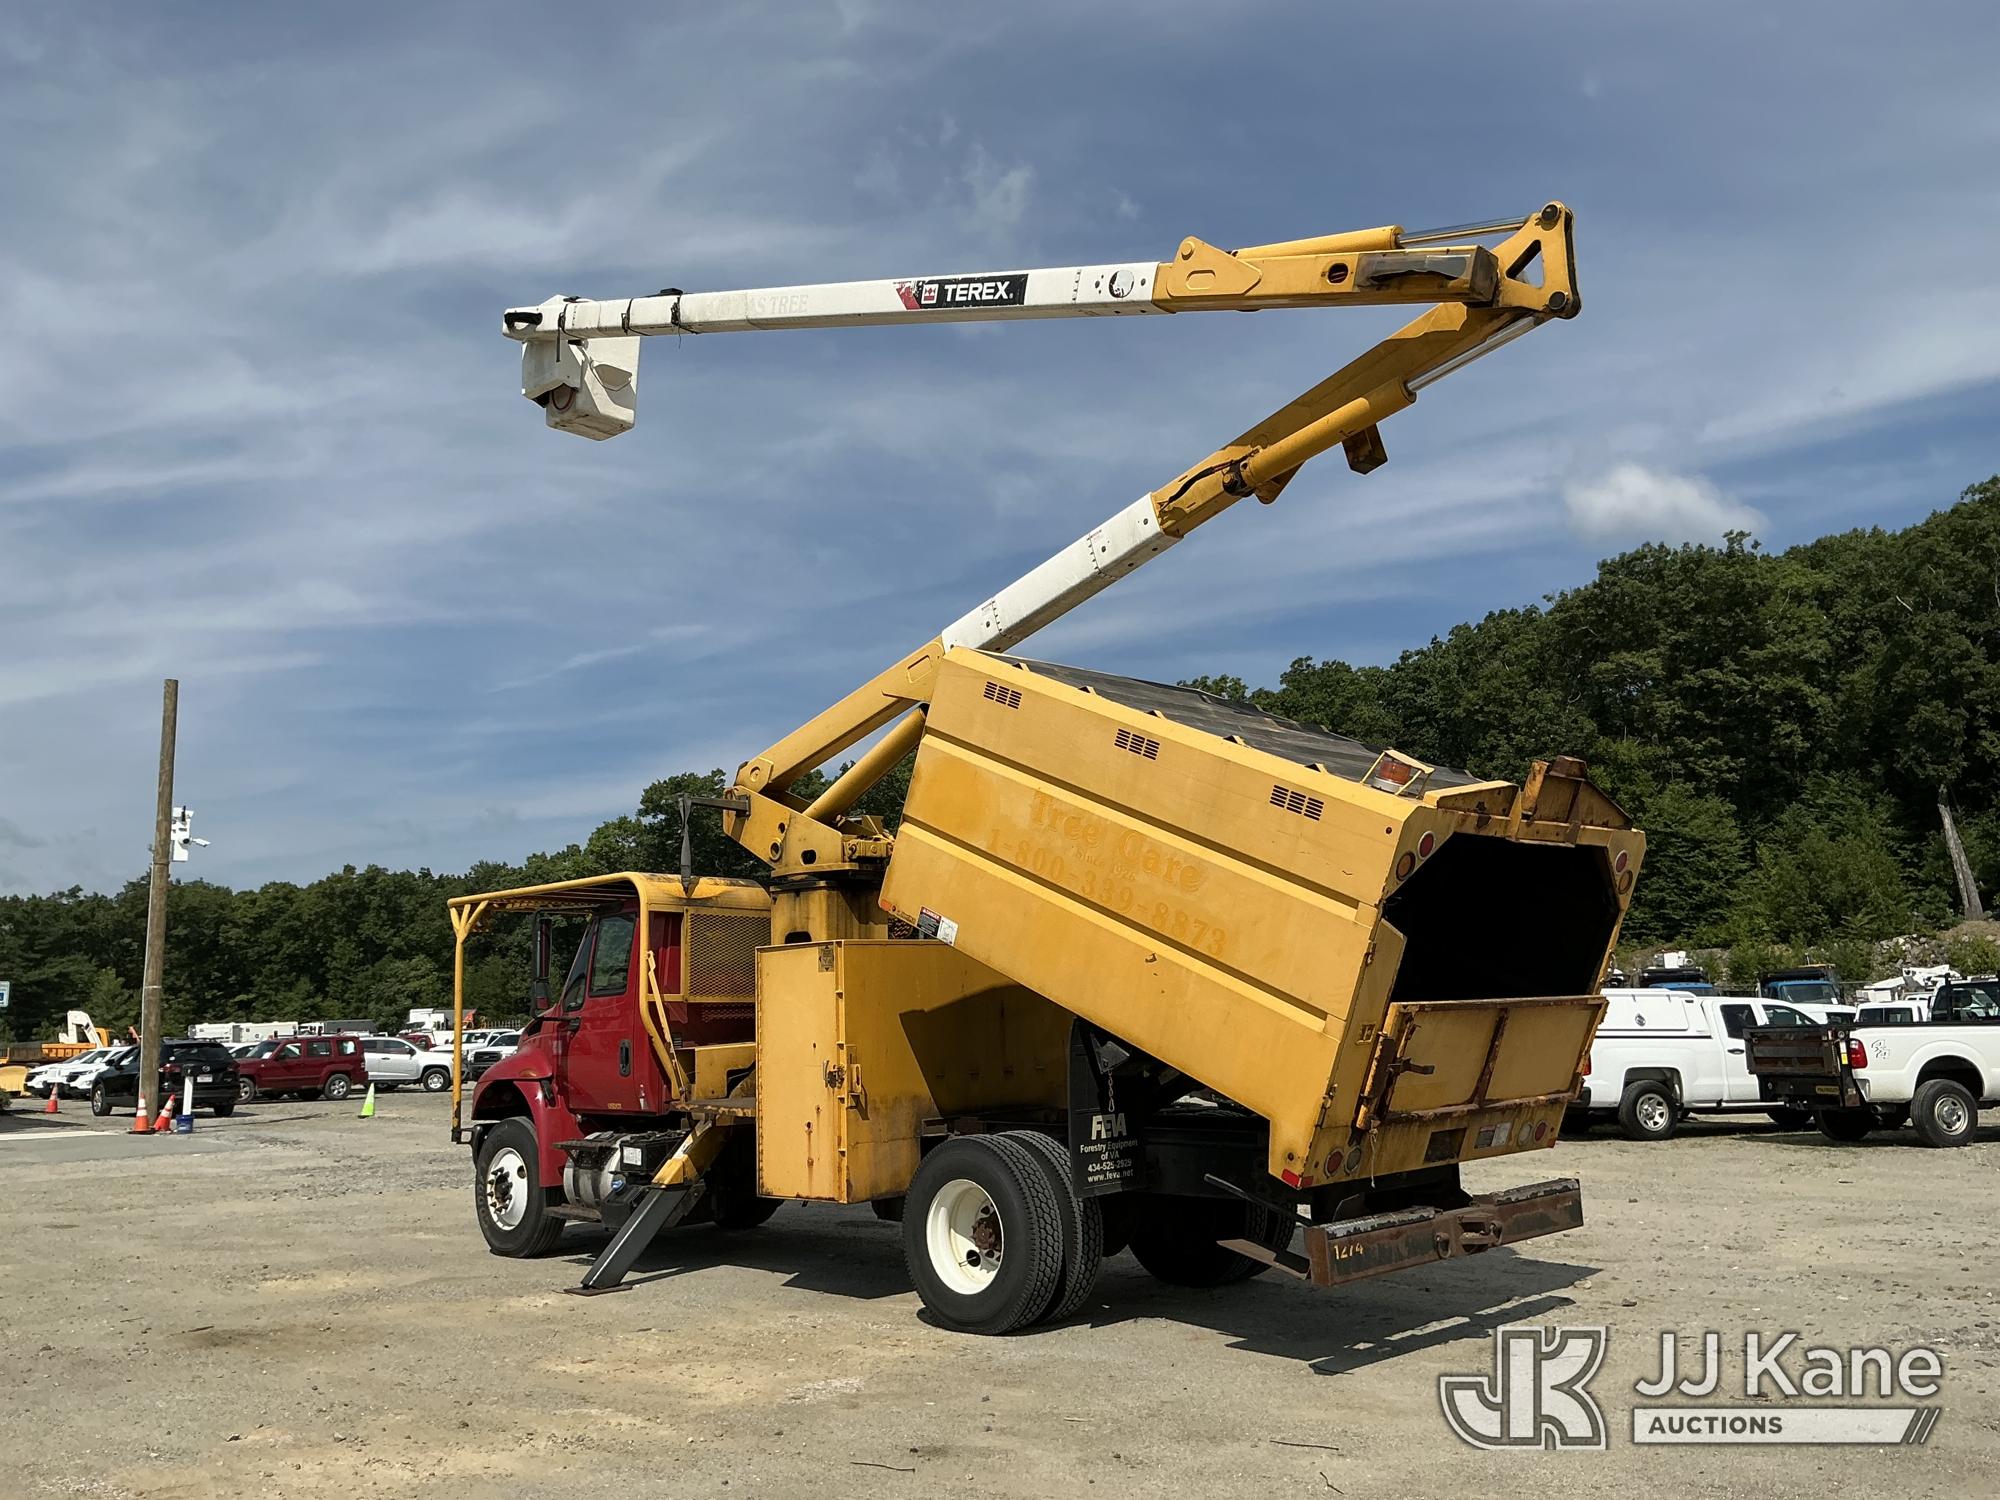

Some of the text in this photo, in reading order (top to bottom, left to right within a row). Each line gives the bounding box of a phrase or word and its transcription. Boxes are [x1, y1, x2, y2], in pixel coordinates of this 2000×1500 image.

[944, 281, 1010, 302] TEREX
[1031, 790, 1202, 894] Tree Care
[1080, 1139, 1138, 1154] Forestry Equipment
[1101, 1150, 1119, 1160] of VA
